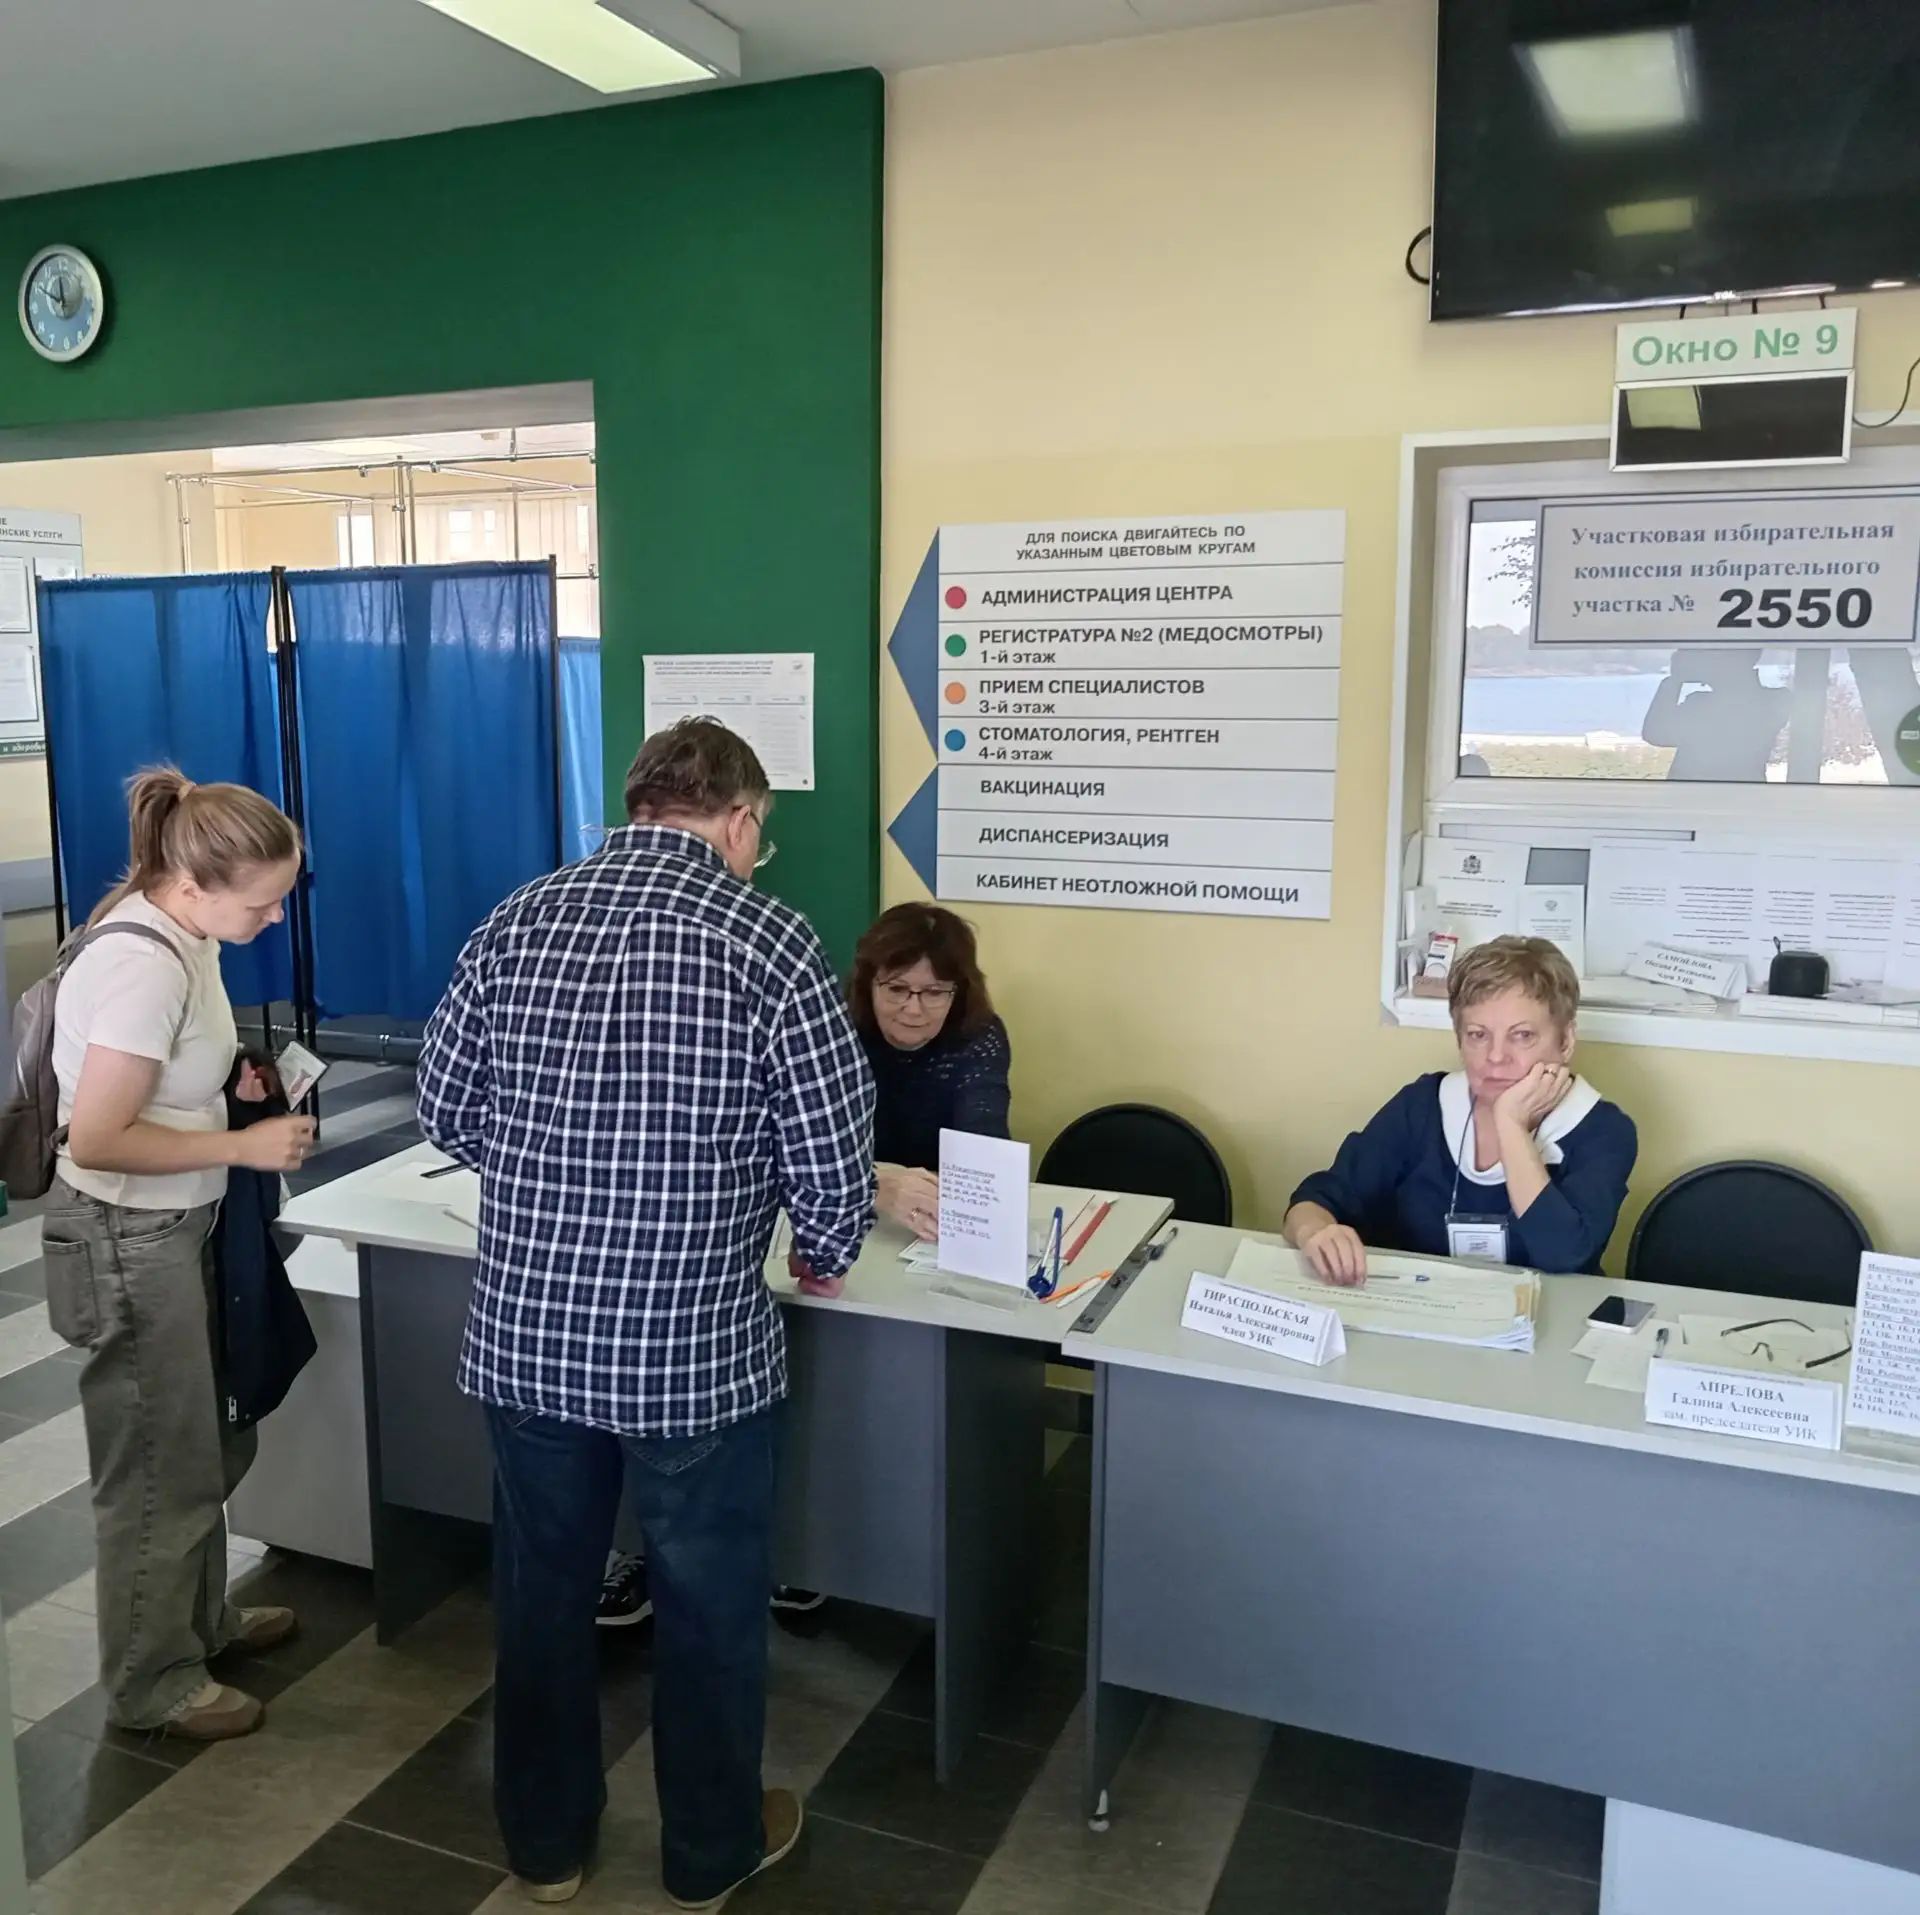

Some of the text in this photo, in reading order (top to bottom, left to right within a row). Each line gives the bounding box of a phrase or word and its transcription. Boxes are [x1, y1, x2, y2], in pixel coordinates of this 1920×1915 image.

[1632, 324, 1838, 366] Окно № 9
[33, 529, 63, 539] УСЛУГИ
[1025, 525, 1245, 545] ДЛЯ ПОИСКА ДВИГАЙТЕСЬ ПО
[1571, 523, 1894, 546] Участковая избирательная
[1016, 542, 1255, 560] УКАЗАННЫМ ЦВЕТОВЫМ КРУГАМ
[1573, 559, 1880, 581] комиссия избирательного
[981, 585, 1233, 607] АДМИНИСТРАЦИЯ ЦЕНТРА
[1572, 587, 1873, 629] участка № 2550
[979, 625, 1323, 645] РЕГИСТРАТУРА №2 (МЕДОСМОТРЫ)
[980, 649, 1056, 664] 1-й этаж
[979, 679, 1205, 696] ПРИЕМ СПЕЦИАЛИСТОВ
[979, 700, 1055, 714] 3-й этаж
[978, 726, 1220, 745] СТОМАТОЛОГИЯ, РЕНТГЕН
[978, 746, 1053, 761] 4-й этаж
[980, 780, 1105, 798] ВАКЦИНАЦИЯ
[978, 827, 1169, 849] ДИСПАНСЕРИЗАЦИЯ
[976, 874, 1299, 904] КАБИНЕТ НЕОТЛОЖНОЙ ПОМОЩИ
[1203, 1288, 1310, 1326] ТИРАСПОЛЬСКАЯ
[1189, 1299, 1315, 1343] Наталья Александровна
[1221, 1325, 1277, 1347] член УИК
[1698, 1380, 1785, 1402] АПРЕЛОВА
[1672, 1392, 1809, 1423] Галина Алексеевна
[1692, 1414, 1780, 1435] председателя
[1785, 1424, 1817, 1440] УИК
